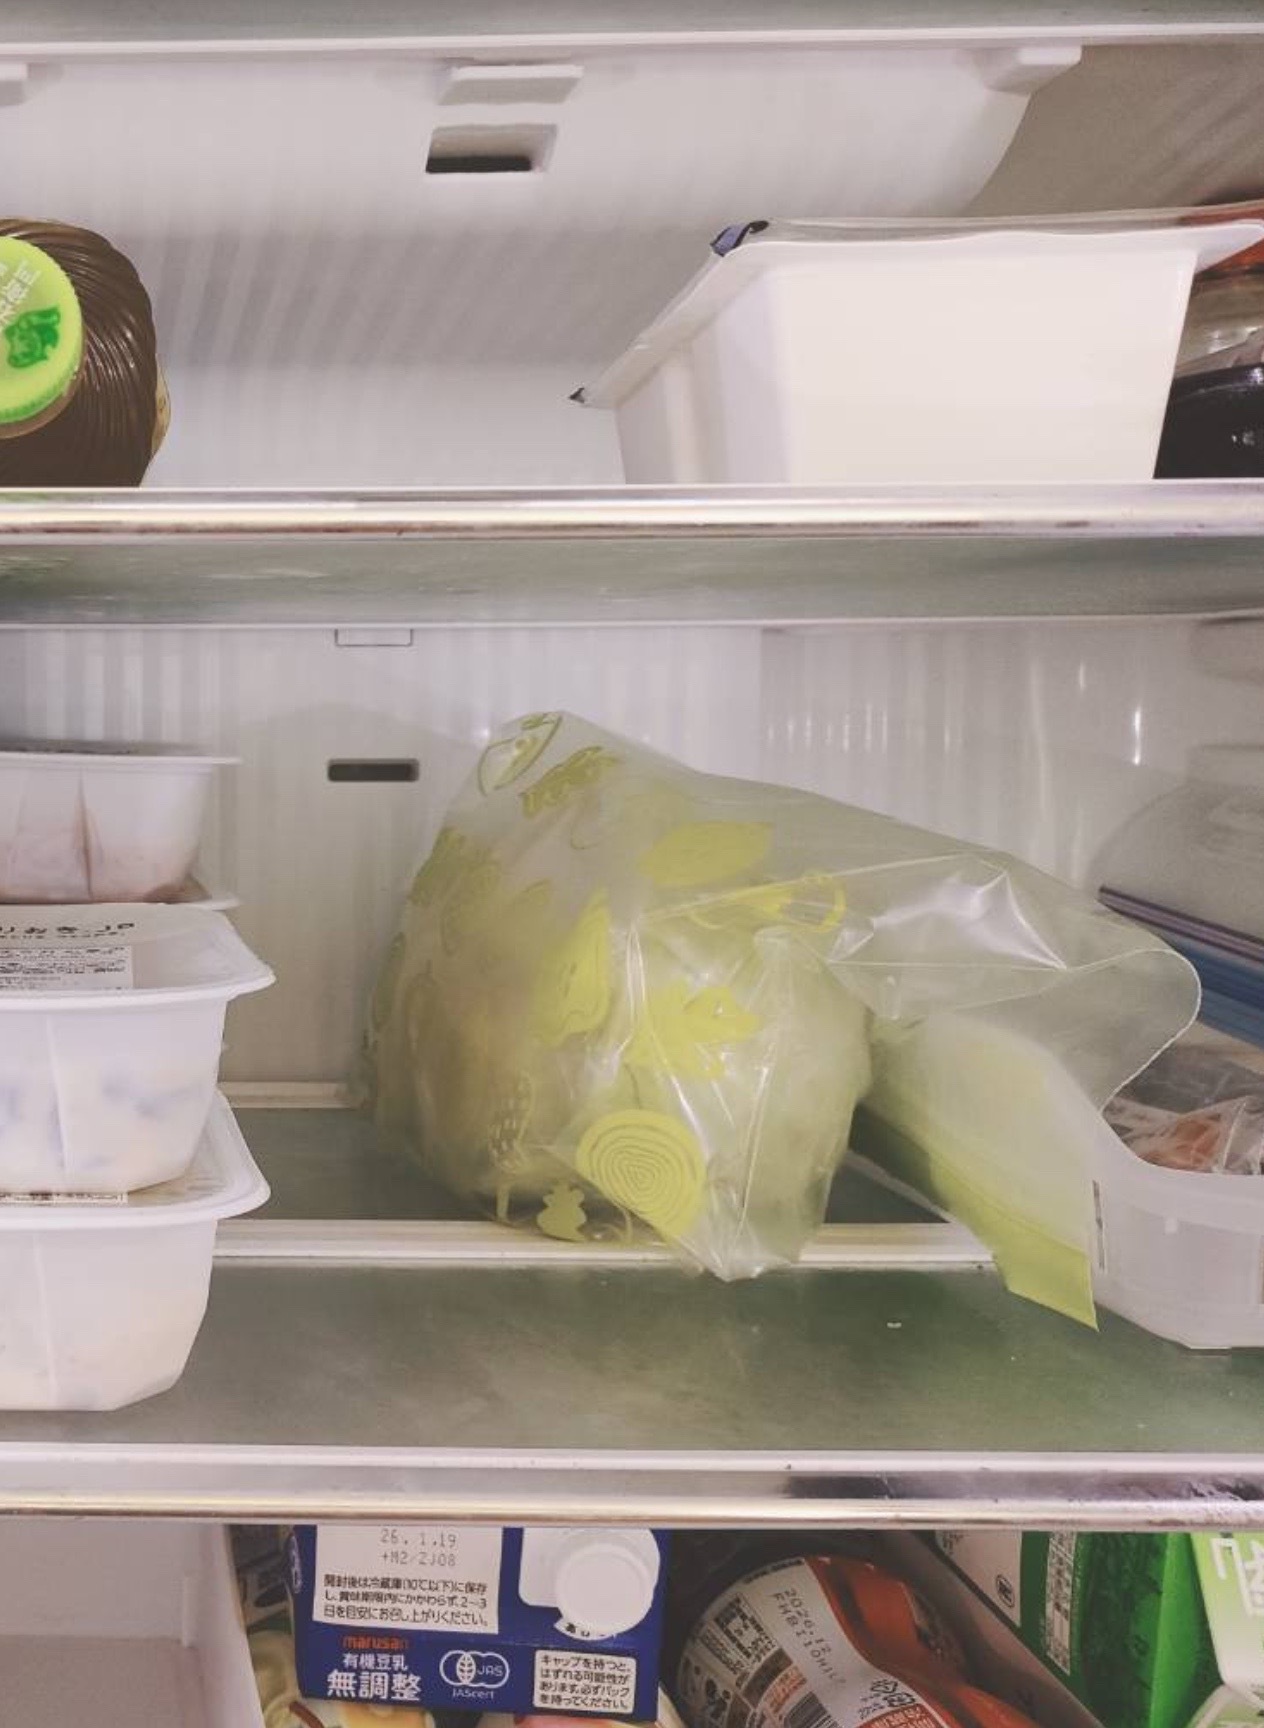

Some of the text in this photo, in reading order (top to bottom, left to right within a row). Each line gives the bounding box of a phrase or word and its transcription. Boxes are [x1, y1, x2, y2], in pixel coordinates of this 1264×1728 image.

[342, 1636, 409, 1649] marusan
[343, 1653, 408, 1671] 有機豆乳
[477, 1665, 503, 1677] JAS
[540, 1668, 629, 1685] はずれる可能性が
[327, 1668, 421, 1701] 無調整
[453, 1688, 495, 1699] JAScert
